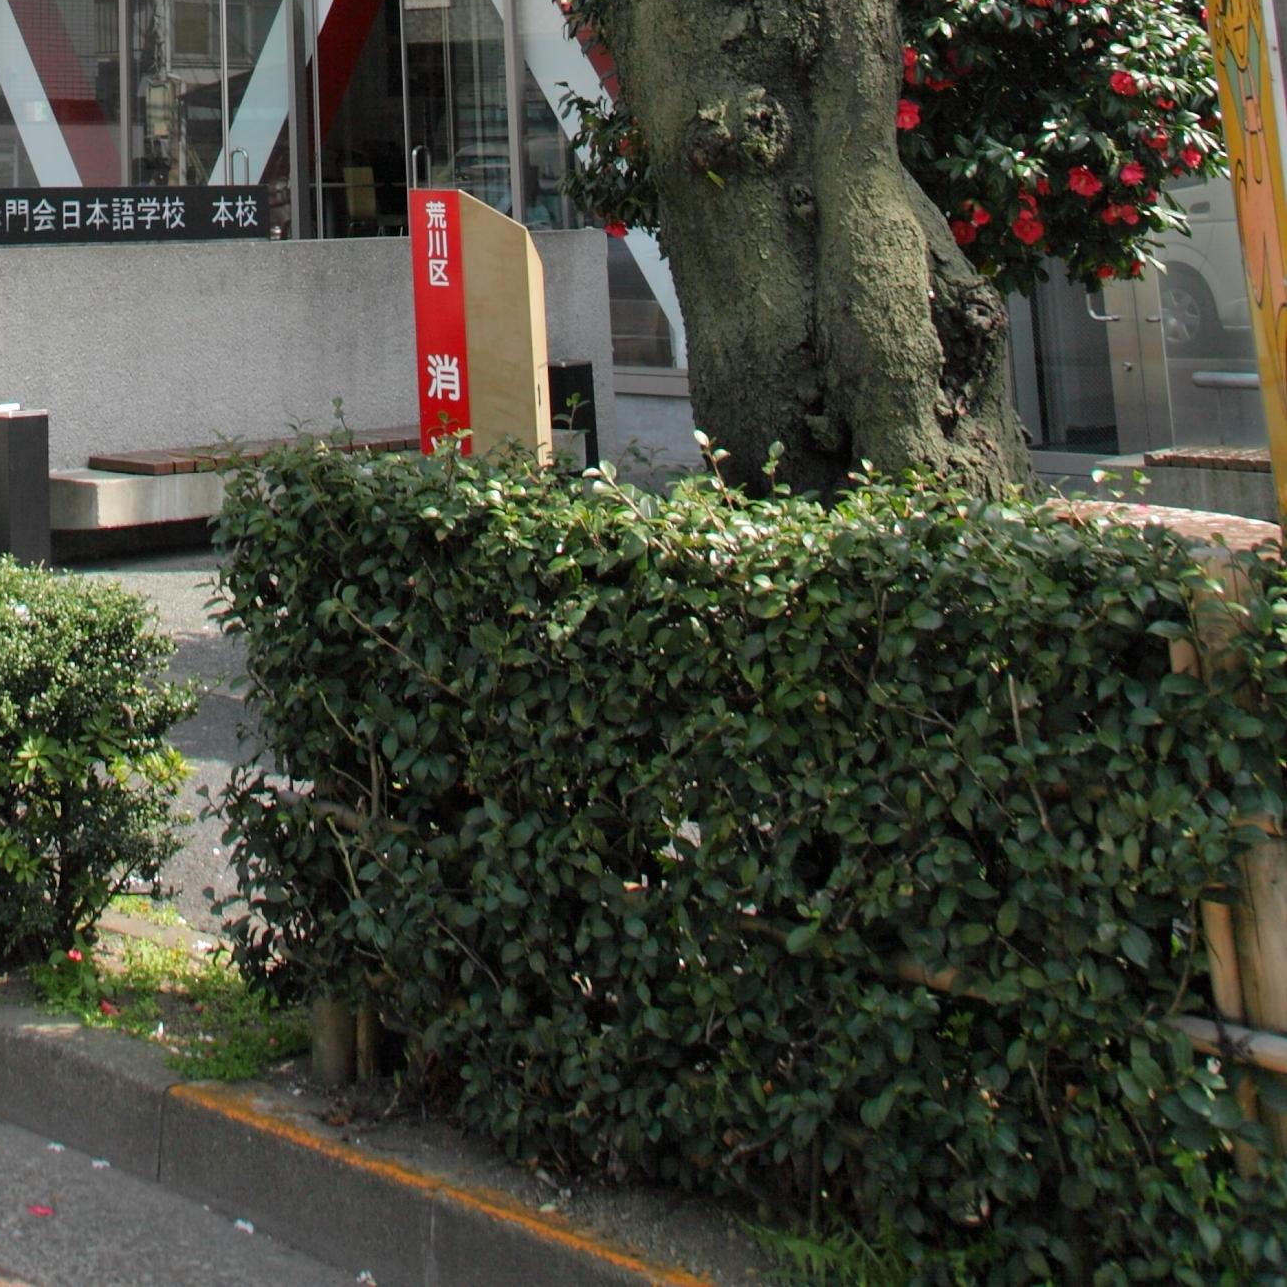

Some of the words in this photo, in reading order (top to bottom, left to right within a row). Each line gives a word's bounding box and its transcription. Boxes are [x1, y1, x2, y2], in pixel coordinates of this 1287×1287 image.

[212, 195, 258, 227] 本校
[426, 201, 450, 286] 荒川区
